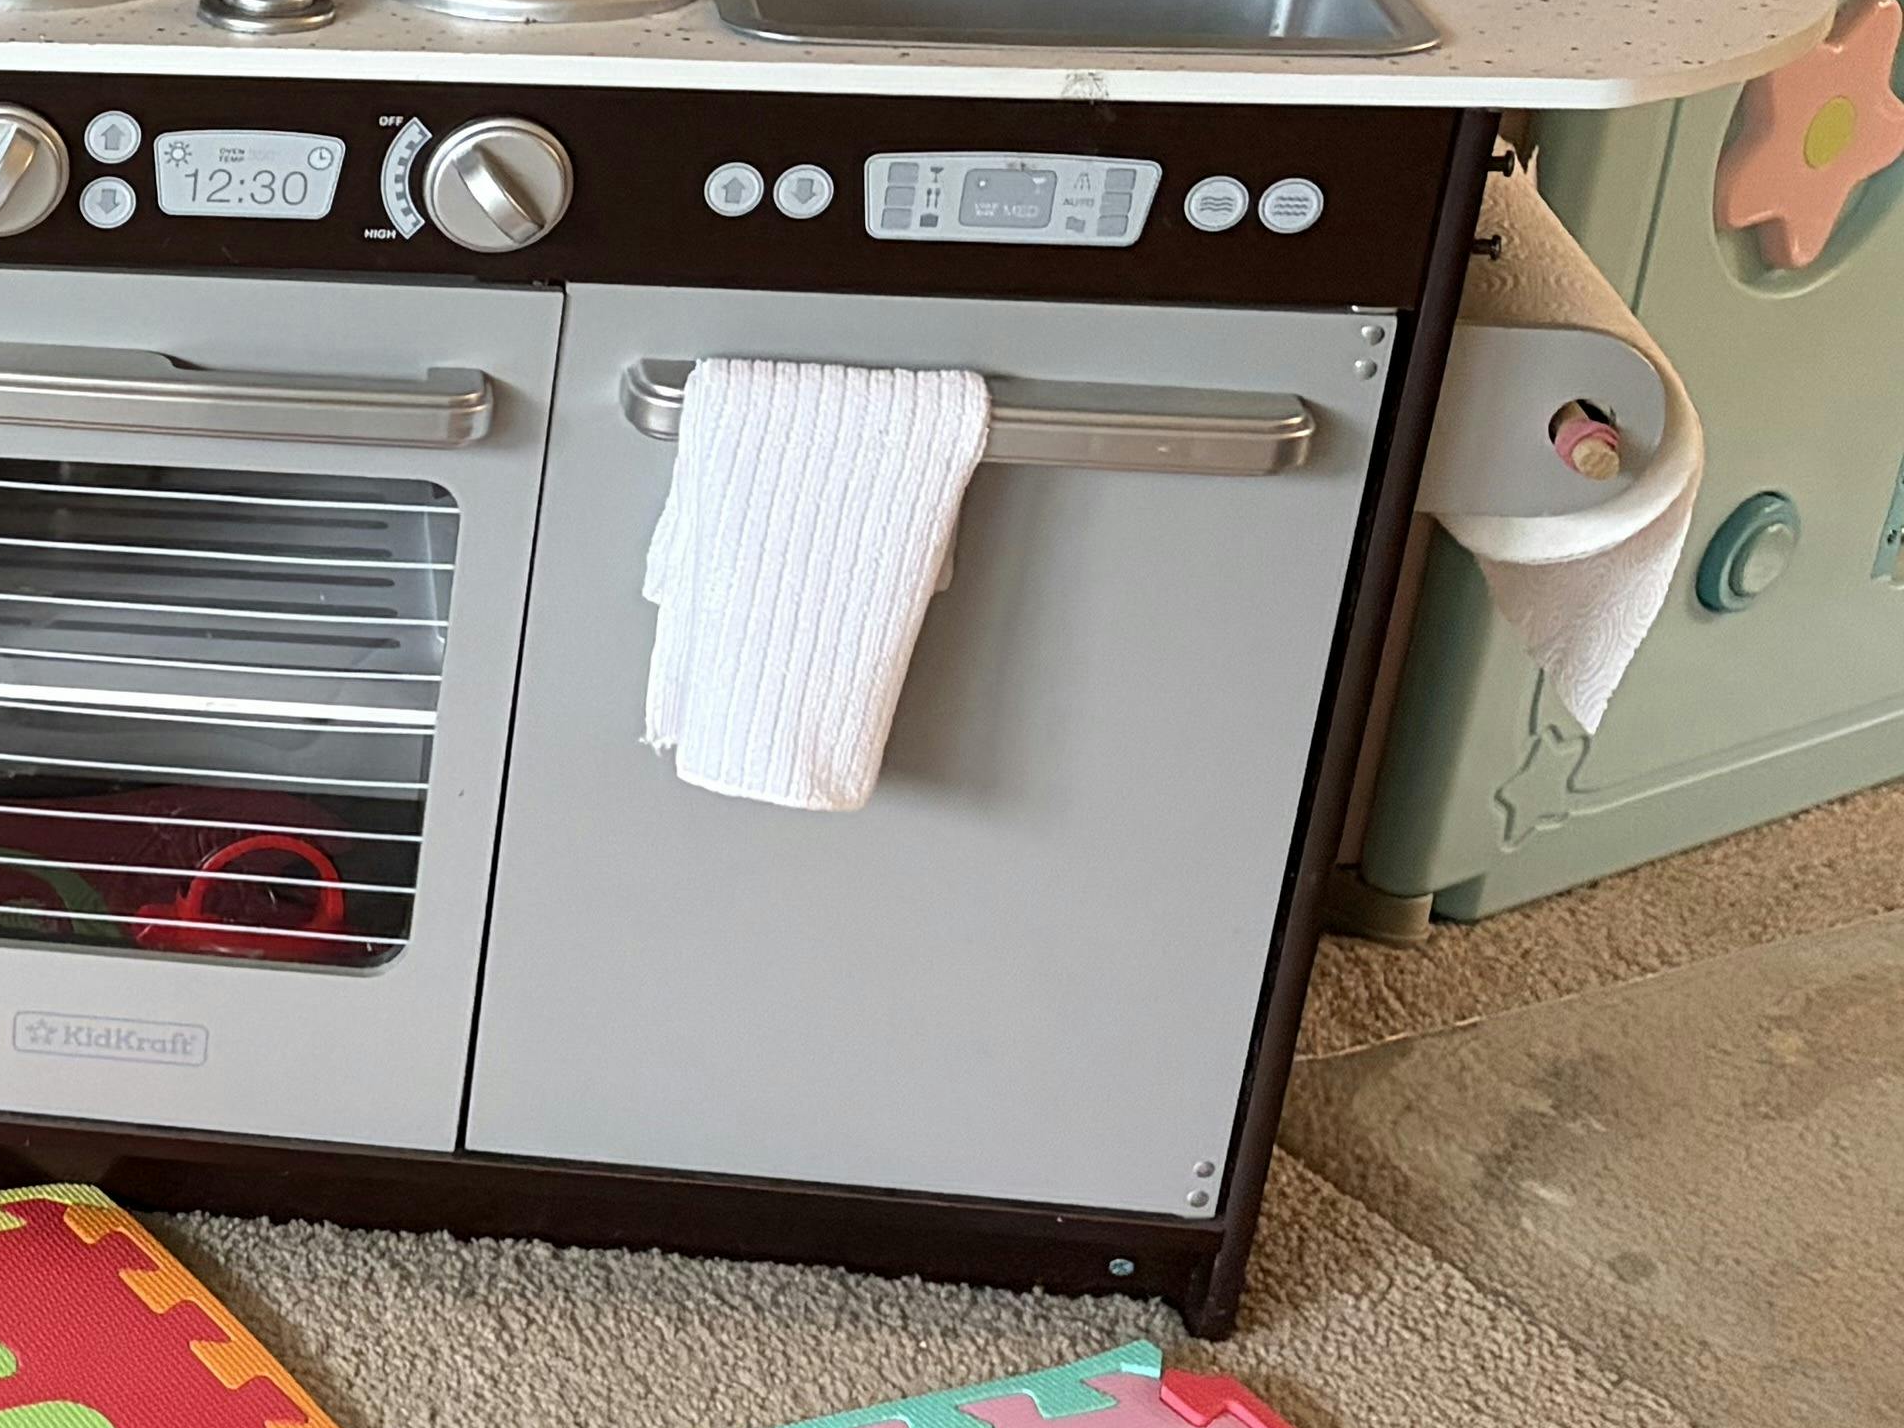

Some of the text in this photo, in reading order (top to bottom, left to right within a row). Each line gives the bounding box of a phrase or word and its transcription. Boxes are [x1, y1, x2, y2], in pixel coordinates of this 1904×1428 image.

[379, 116, 404, 127] OFF
[219, 147, 245, 155] OVEN
[185, 168, 308, 206] 12:30
[364, 228, 397, 239] HIGH
[63, 1025, 193, 1056] KidKraft
